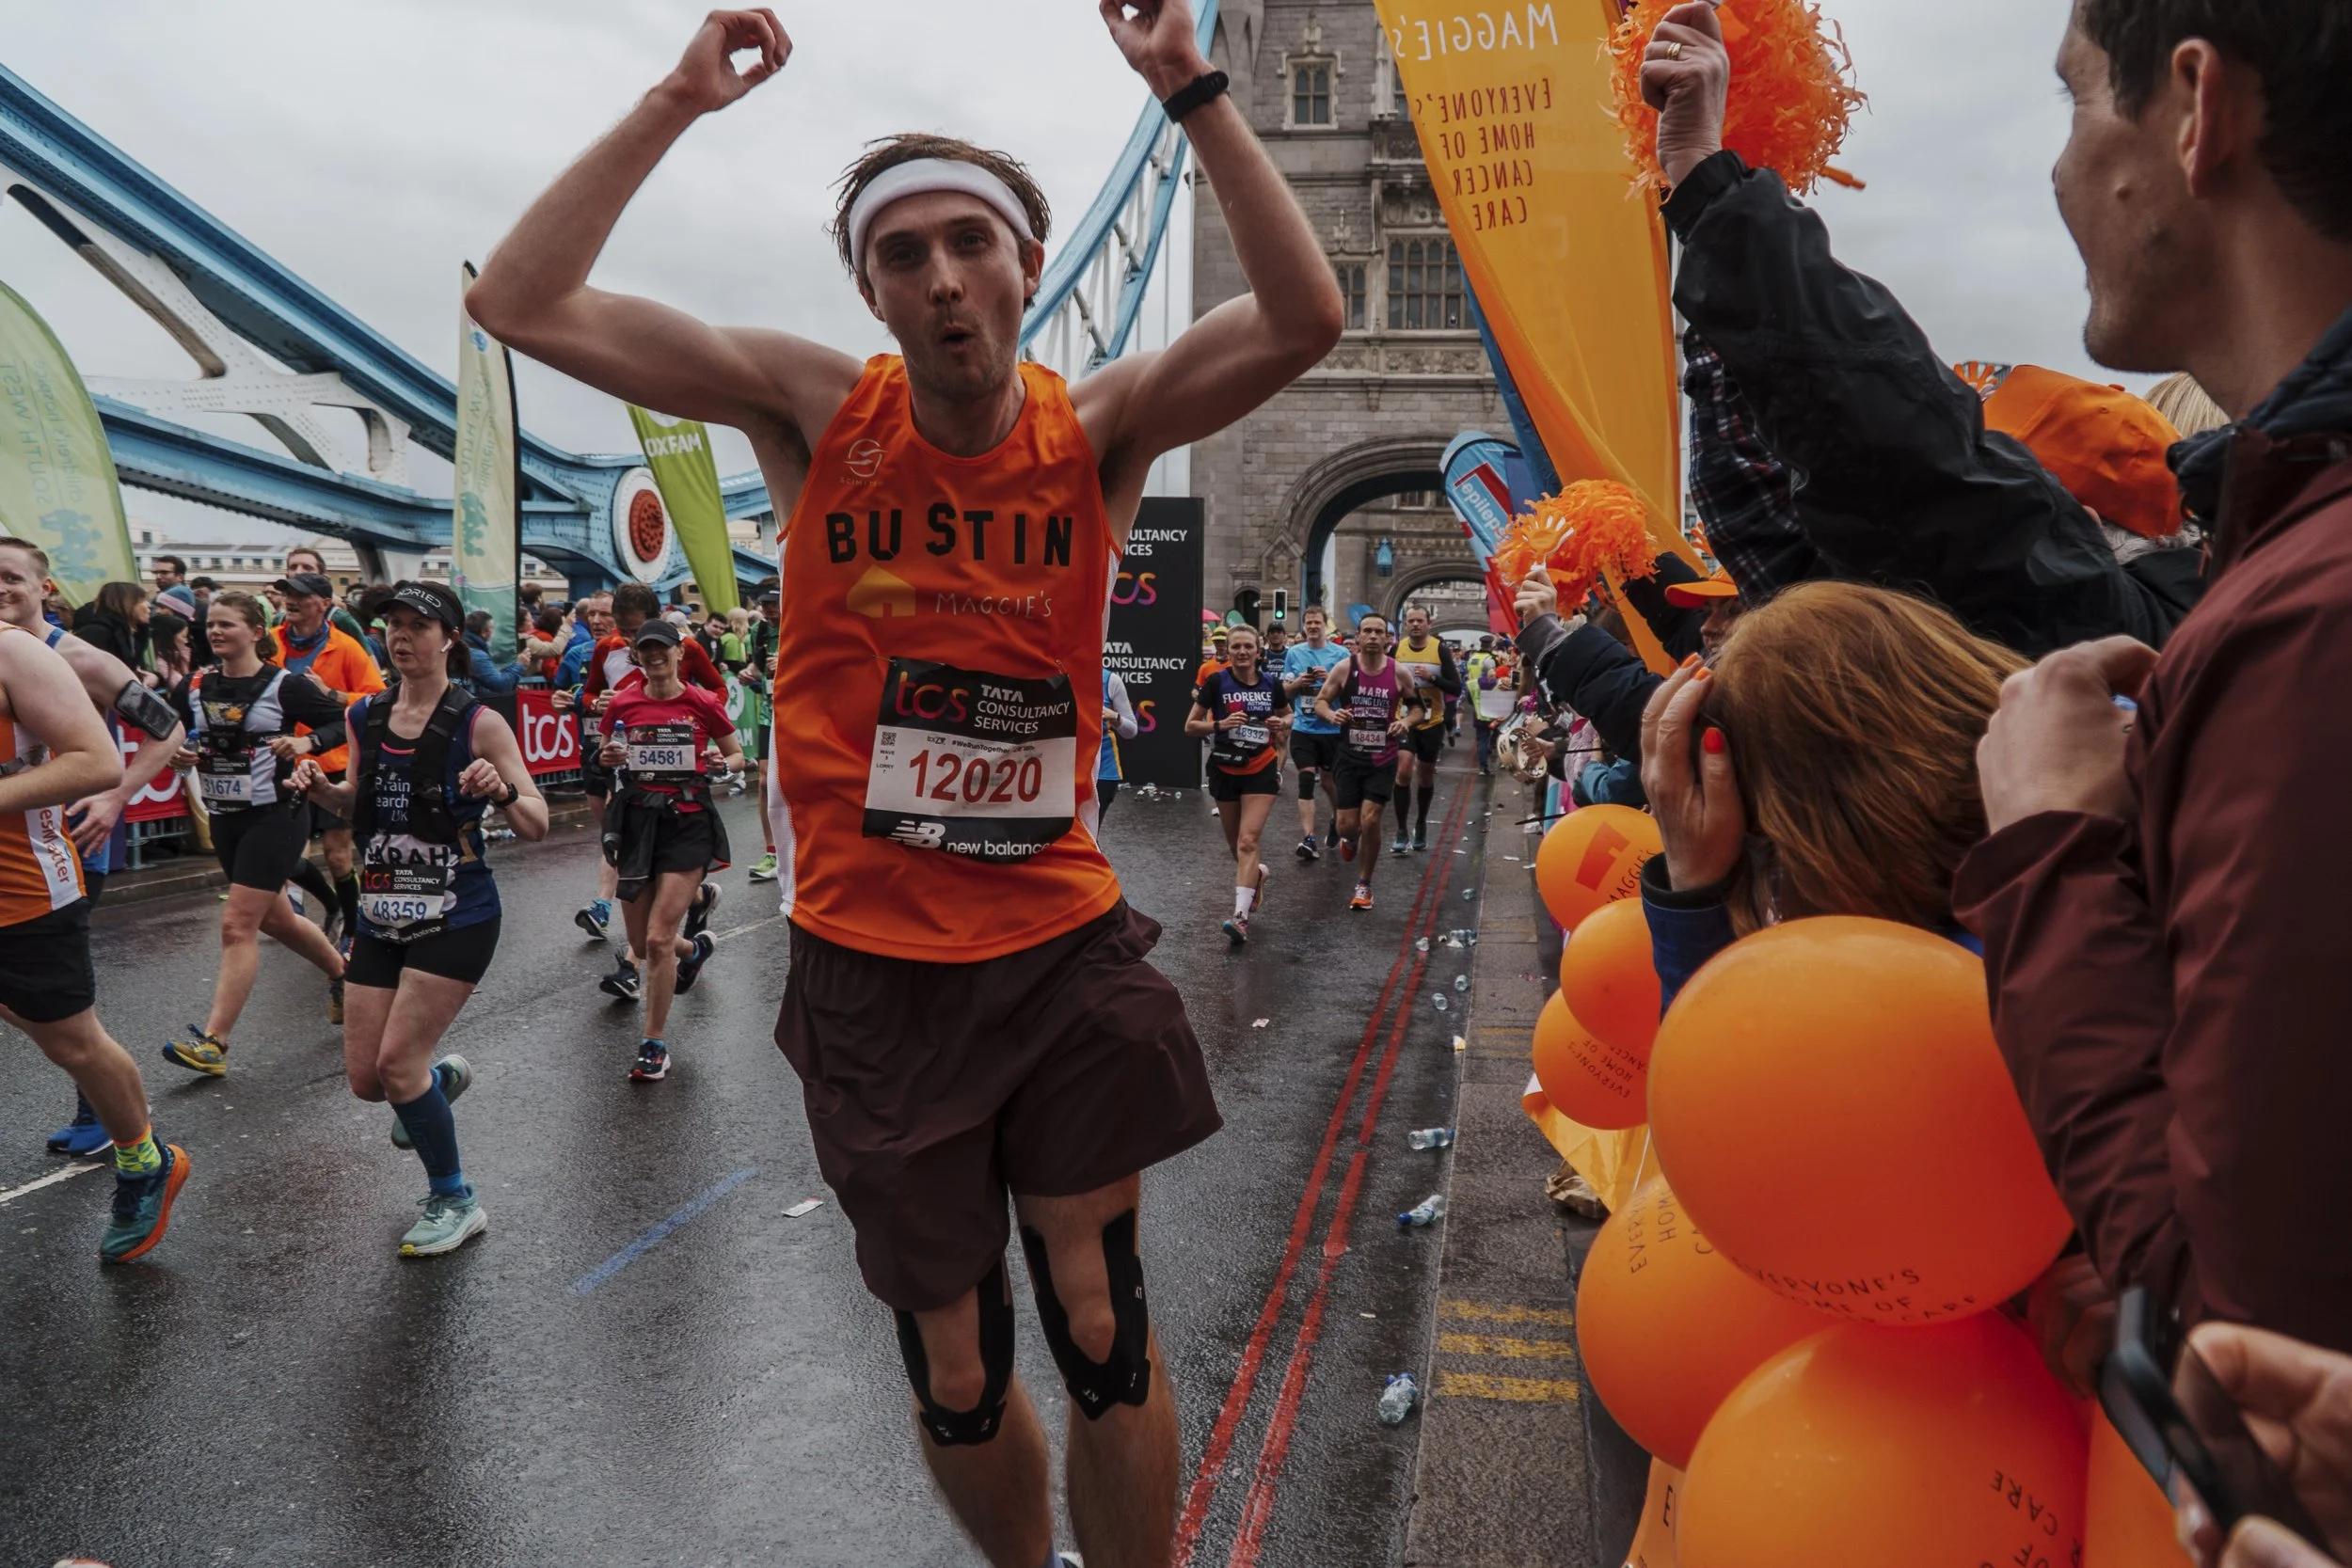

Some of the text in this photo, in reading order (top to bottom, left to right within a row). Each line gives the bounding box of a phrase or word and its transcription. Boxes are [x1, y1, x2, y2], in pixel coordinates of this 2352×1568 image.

[644, 432, 703, 458] OXFAM
[825, 502, 1073, 567] BUSTIN
[935, 590, 1053, 619] MAGGIE'S
[895, 671, 970, 723] tcs
[980, 683, 1025, 704] TATA
[1222, 691, 1273, 705] FLORENCE
[1351, 696, 1373, 706] YOUNG
[1358, 686, 1390, 699] MARK
[977, 700, 1072, 719] CONSULTANCY
[522, 703, 574, 763] tcs
[973, 716, 1040, 735] SERVICES
[951, 739, 1010, 754] #WeRunTogether
[639, 750, 683, 766] 54581
[909, 749, 1042, 804] 12020
[204, 779, 242, 796] 31674
[946, 840, 981, 855] new
[393, 877, 441, 885] CONSULTANCY
[372, 900, 428, 923] 48359
[1600, 1054, 1634, 1083] HOME
[1611, 1046, 1648, 1076] ANCE
[1990, 1469, 2058, 1537] CARE
